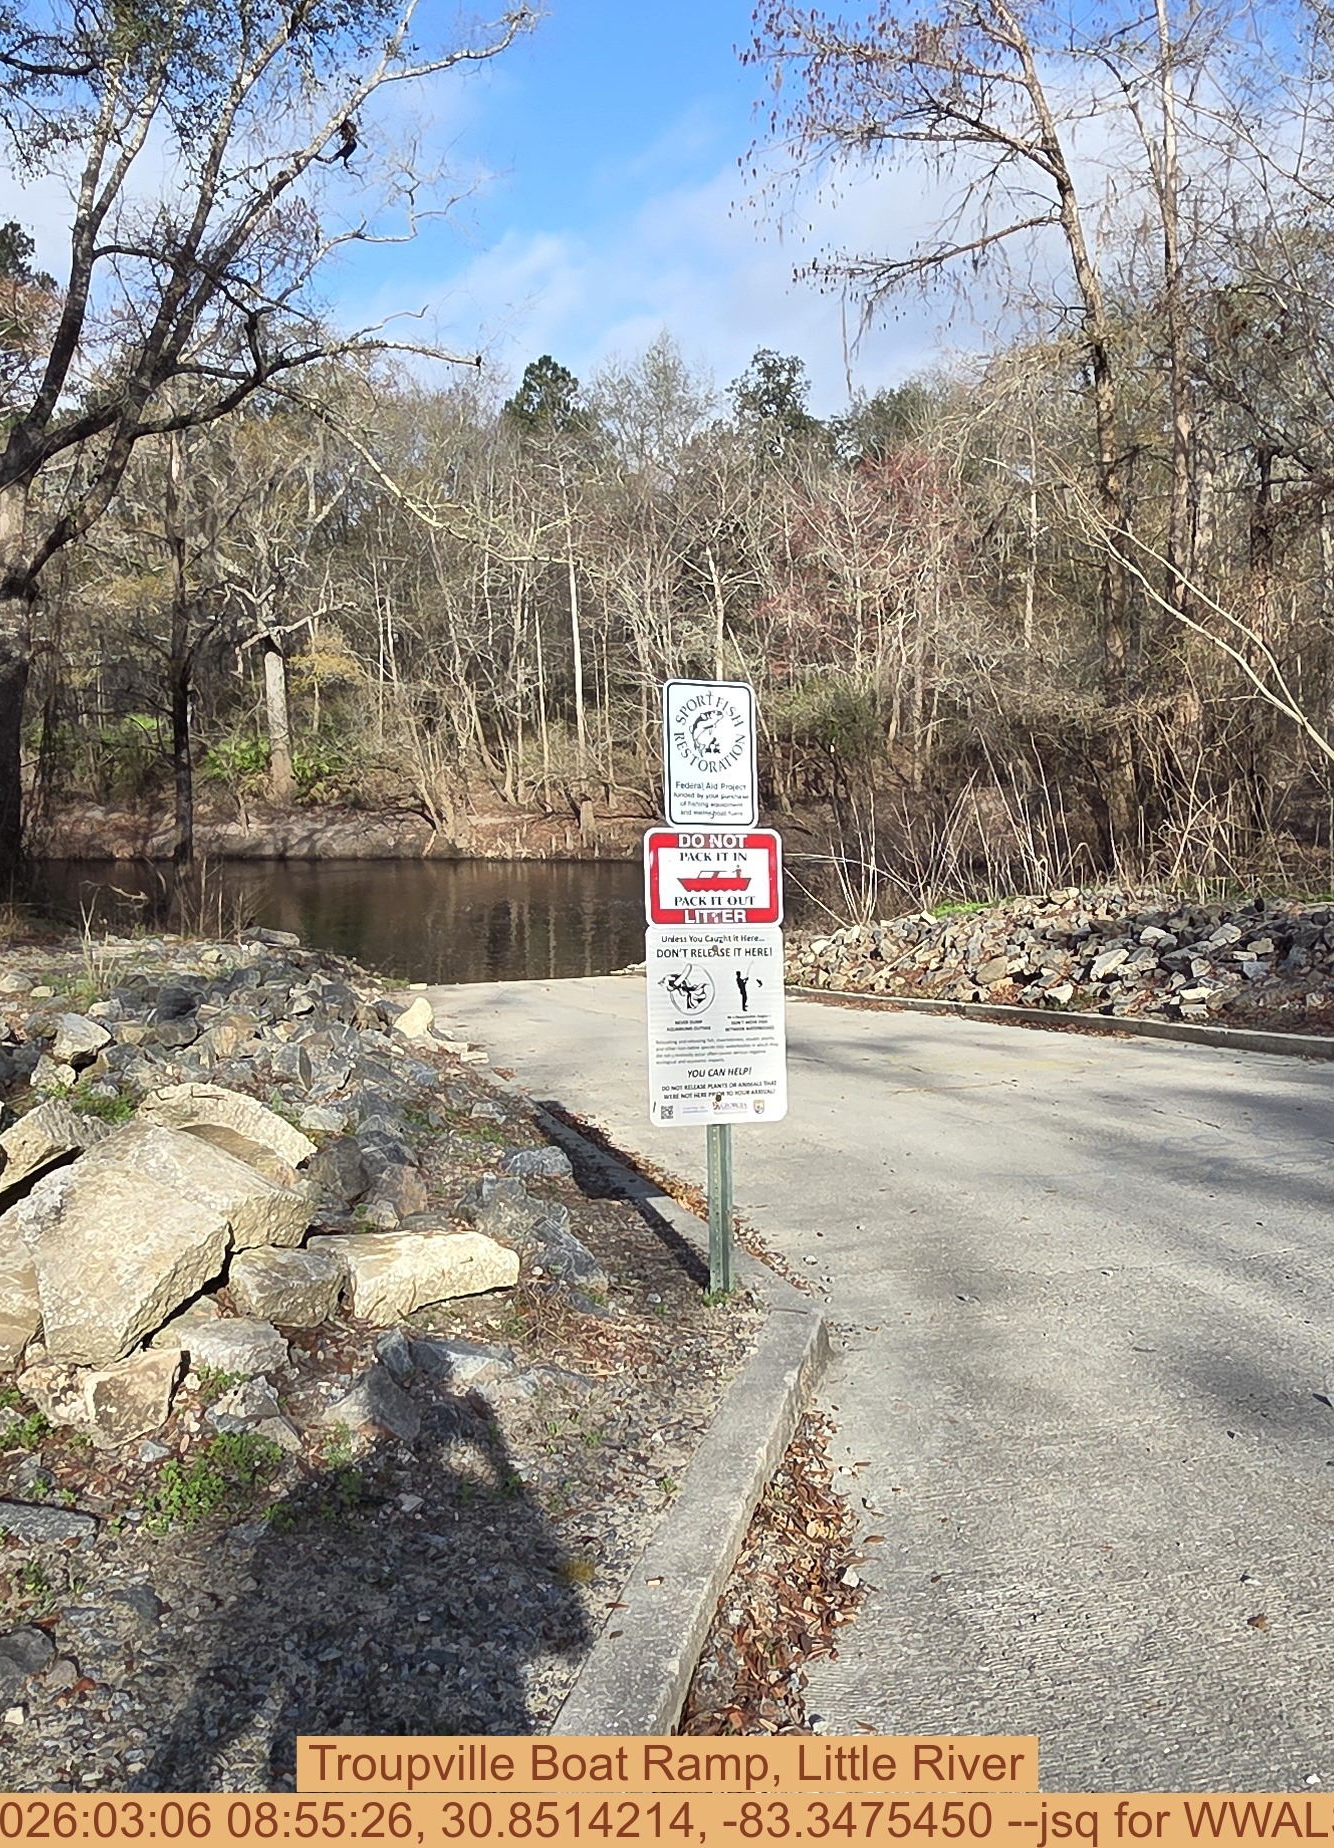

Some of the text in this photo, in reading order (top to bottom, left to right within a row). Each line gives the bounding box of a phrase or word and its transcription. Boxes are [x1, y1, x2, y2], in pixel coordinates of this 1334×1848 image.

[675, 690, 744, 728] SPORT FISH
[673, 732, 745, 773] RESTORATION
[675, 781, 746, 791] Federal Aid Project
[679, 834, 748, 848] DO NOT
[680, 852, 747, 861] PACK IT IN
[674, 896, 756, 906] PACK IT OUT
[684, 909, 747, 924] LITTER
[661, 935, 687, 943] Unless
[705, 935, 732, 943] Caught
[656, 947, 772, 958] DON'T RELEASE IT HERE!
[687, 1066, 752, 1078] YOU CAN HELP!
